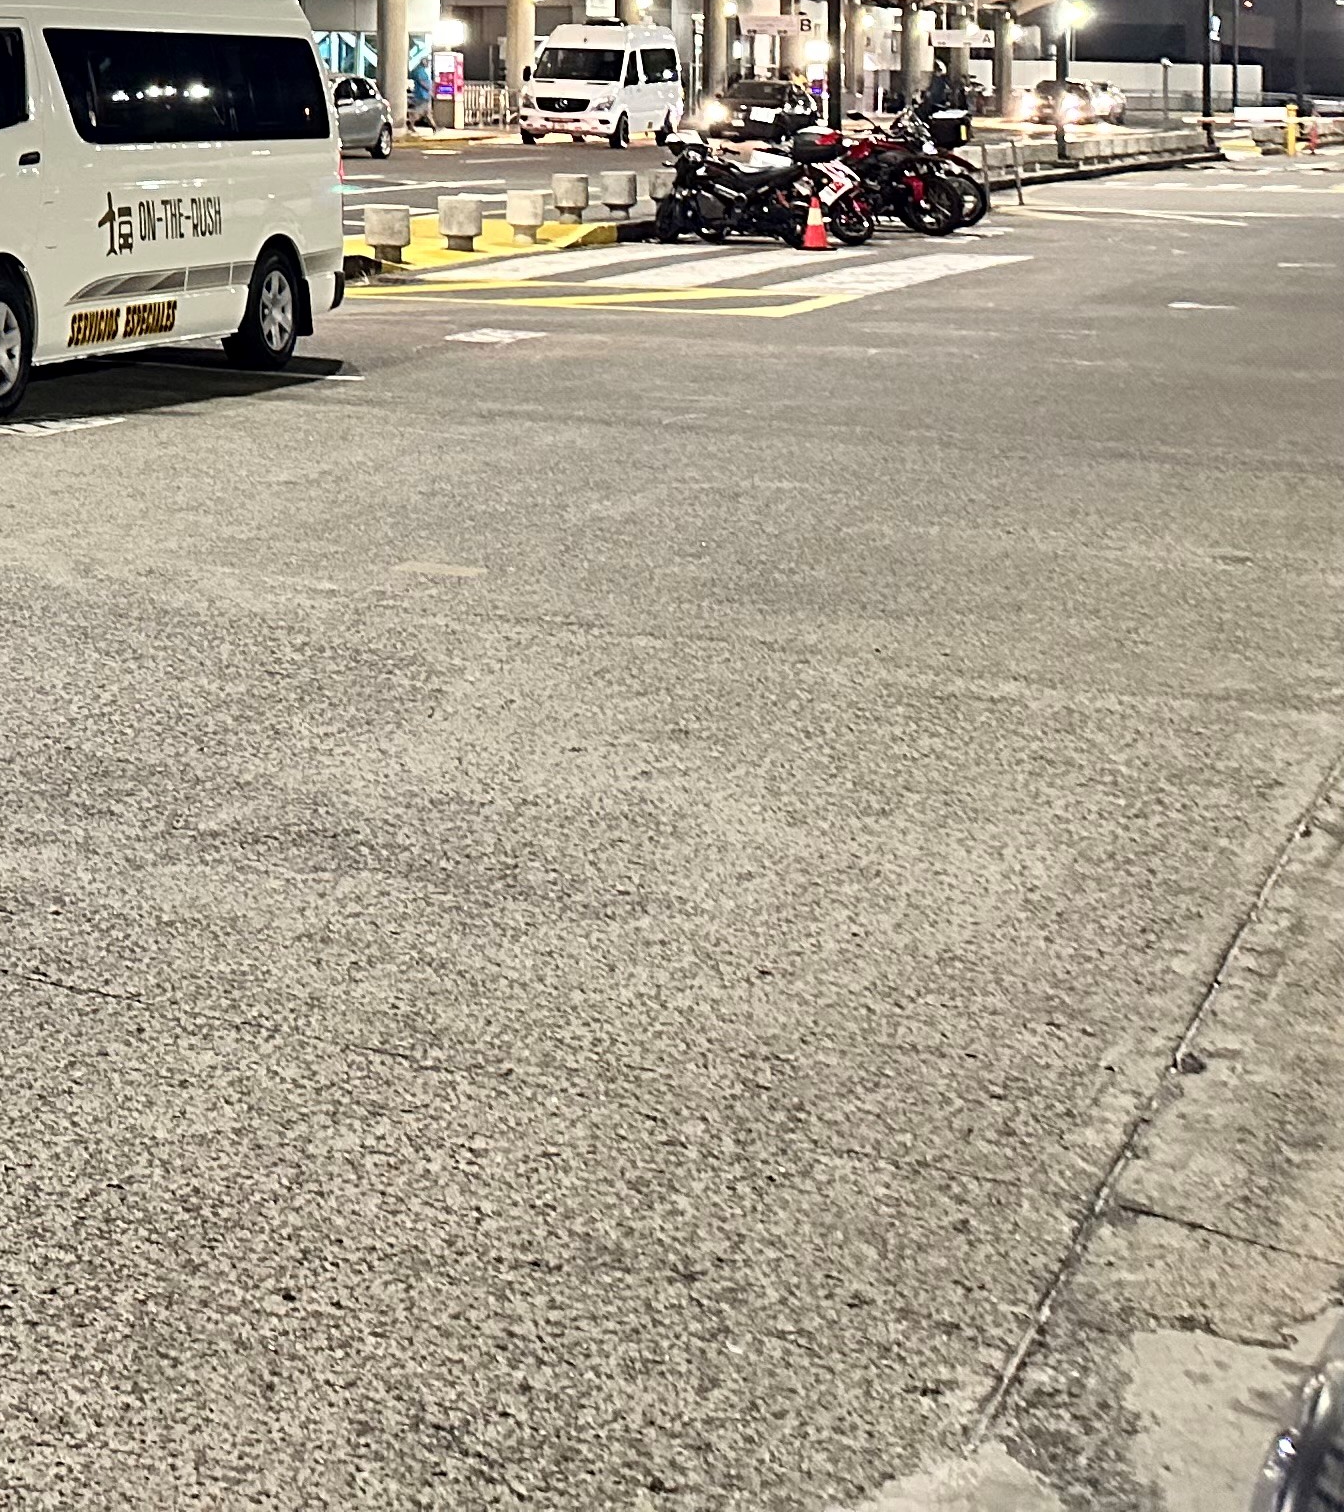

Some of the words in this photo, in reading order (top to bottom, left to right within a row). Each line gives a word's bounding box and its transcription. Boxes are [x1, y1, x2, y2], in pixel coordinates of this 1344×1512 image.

[800, 18, 812, 32] B
[138, 196, 222, 242] ON-THE-RUSH
[67, 308, 120, 348] SERVICIOS
[123, 299, 178, 338] ESPECIALES
